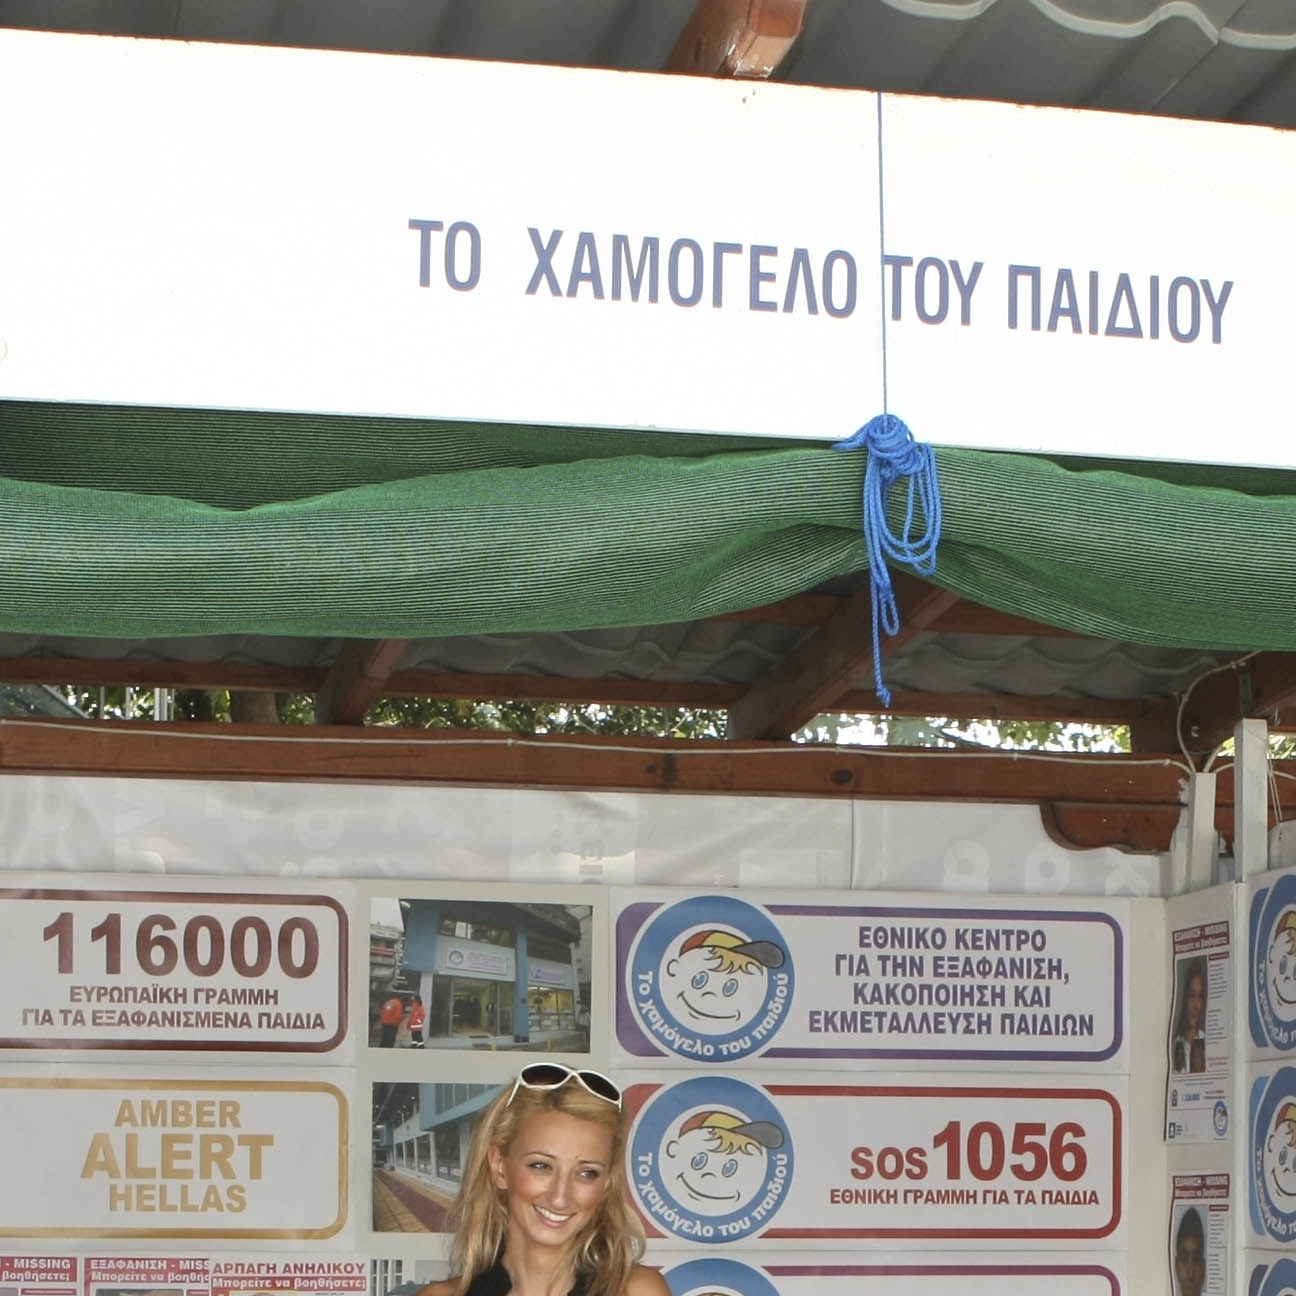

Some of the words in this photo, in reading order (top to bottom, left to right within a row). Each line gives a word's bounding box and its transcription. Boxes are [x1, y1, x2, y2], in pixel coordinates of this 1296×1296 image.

[409, 219, 482, 291] ΤΟ
[525, 227, 859, 320] ΧΑΜΟΓΕΛΟ
[882, 254, 984, 325] ΤΟΥ
[1007, 264, 1235, 344] ΠΑΙΔΙΟΥ
[43, 911, 320, 978] 116000
[859, 926, 947, 950] ΕΘΝΙΚΟ
[956, 929, 1046, 952] ΚΕΝΤΡΟ
[834, 954, 871, 977] ΓΙΑ
[876, 955, 924, 978] ΤΗΝ
[932, 955, 1070, 983] ΕΞΑΦΑΝΙΣΗ,
[70, 984, 188, 1005] ΕΥΡΩΠΑΪΚΗ
[194, 987, 279, 1005] ΓΡΑΜΜΗ
[638, 971, 653, 998] Το
[853, 983, 1005, 1007] ΚΑΚΟΠΟΙΗΣΗ
[1014, 986, 1051, 1007] ΚΑΙ
[22, 1009, 55, 1027] ΓΙΑ
[59, 1009, 87, 1027] ΤΑ
[91, 1009, 252, 1029] ΕΞΑΦΑΝΙΣΜΕΝΑ
[256, 1012, 326, 1030] ΠΑΙΔΙΑ
[752, 973, 789, 1044] παιδιού
[639, 1000, 714, 1056] χαμόγελο
[808, 1011, 992, 1035] ΕΚΜΕΤΑΛΛΕΥΣΗ
[1000, 1013, 1095, 1037] ΠΑΙΔΙΩΝ
[719, 1036, 752, 1056] του
[115, 1099, 241, 1129] AMBER
[80, 1133, 274, 1181] ALERT
[932, 1120, 1087, 1182] 1056
[109, 1184, 247, 1213] HELLAS
[830, 1188, 898, 1205] ΕΘΝΙΚΗ
[904, 1188, 977, 1205] ΓΡΑΜΜΗ
[982, 1189, 1010, 1205] ΓΙΑ
[1015, 1189, 1038, 1205] ΤΑ
[1042, 1190, 1100, 1206] ΠΑΙΔΙΑ
[13, 1258, 71, 1270] MISSING
[90, 1259, 167, 1270] ΕΞΑΦΑΝΙΣΗ
[91, 1271, 147, 1282] Μπορείτε
[150, 1273, 164, 1281] να
[213, 1262, 277, 1274] ΑΡΠΑΓΗ
[282, 1262, 366, 1274] ΑΝΗΛΙΚΟΥ
[212, 1277, 272, 1289] Μπορείτε
[276, 1280, 290, 1288] να
